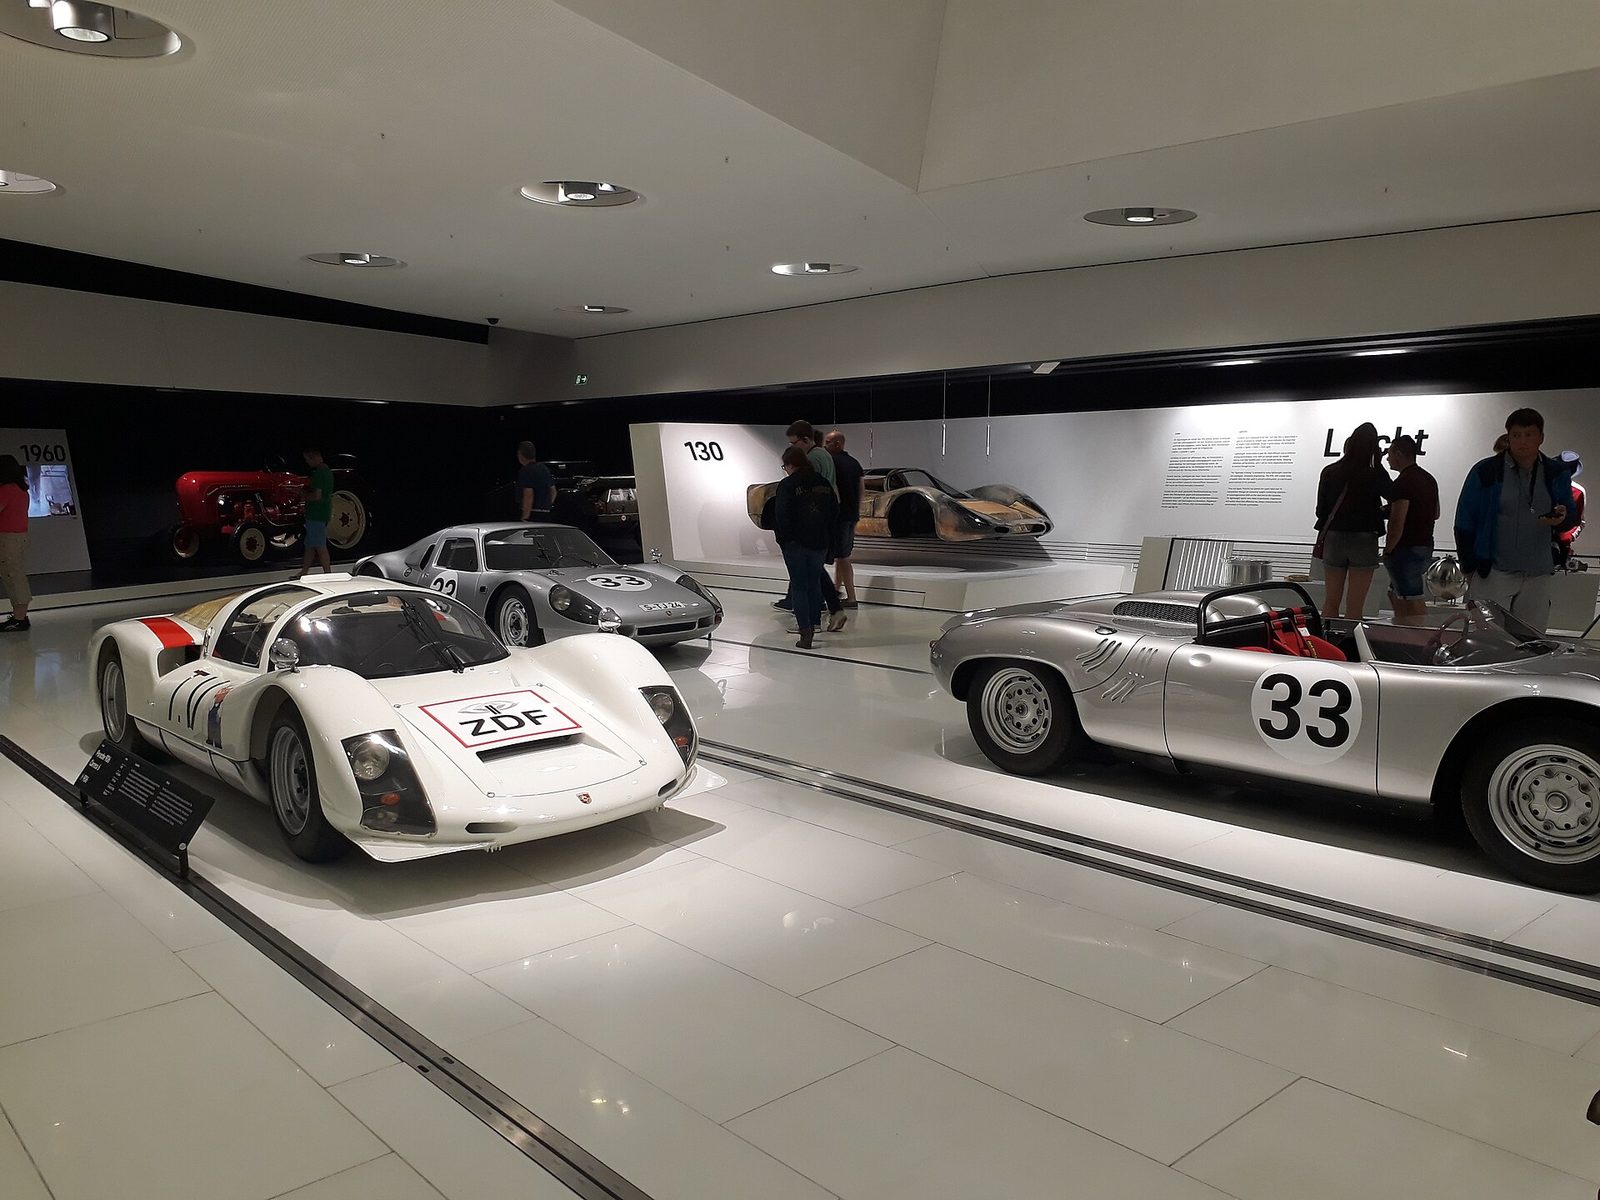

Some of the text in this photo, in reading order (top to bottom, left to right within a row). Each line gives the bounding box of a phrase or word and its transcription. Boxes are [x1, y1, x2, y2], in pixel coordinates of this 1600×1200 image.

[20, 444, 66, 462] 1960
[683, 441, 724, 461] 130
[590, 575, 645, 588] 33
[1259, 673, 1353, 748] 33
[458, 709, 548, 737] ZDF
